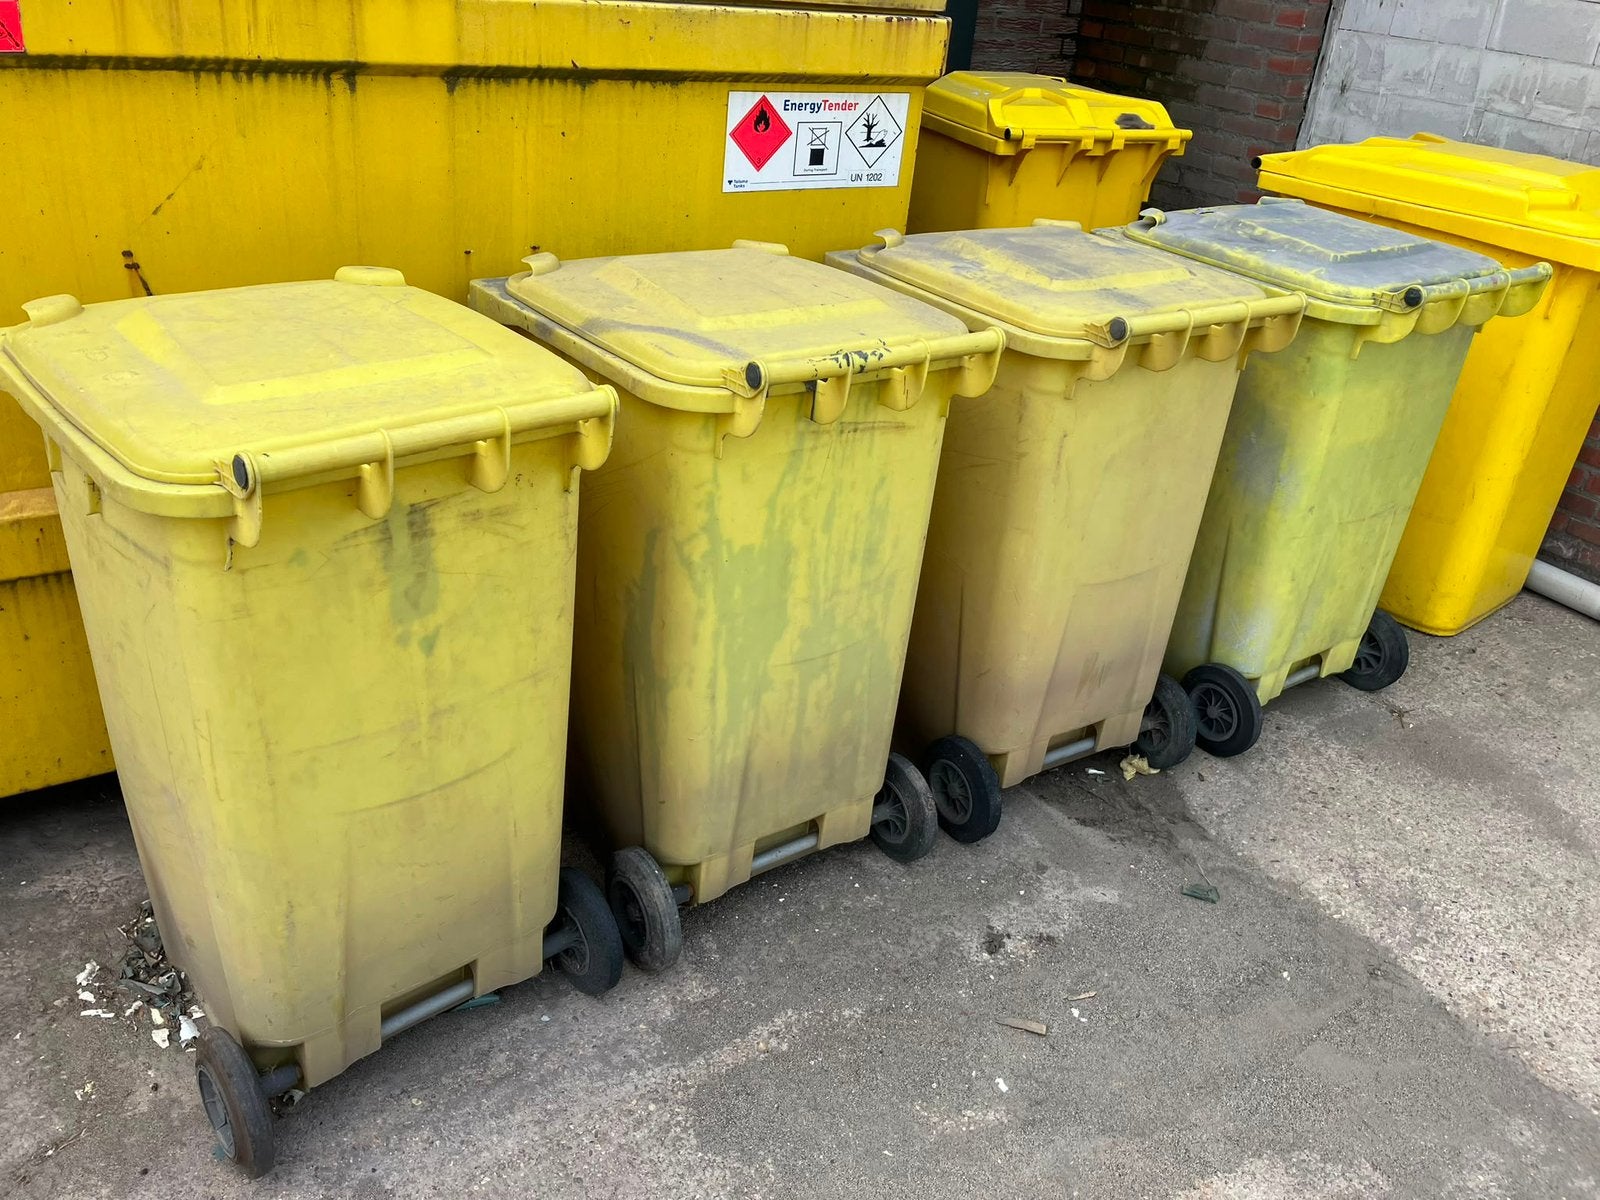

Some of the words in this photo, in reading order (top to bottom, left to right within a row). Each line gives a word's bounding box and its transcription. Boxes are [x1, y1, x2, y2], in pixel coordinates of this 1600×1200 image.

[783, 99, 859, 114] EnergyTender
[850, 173, 863, 182] UN
[866, 172, 883, 182] 1202
